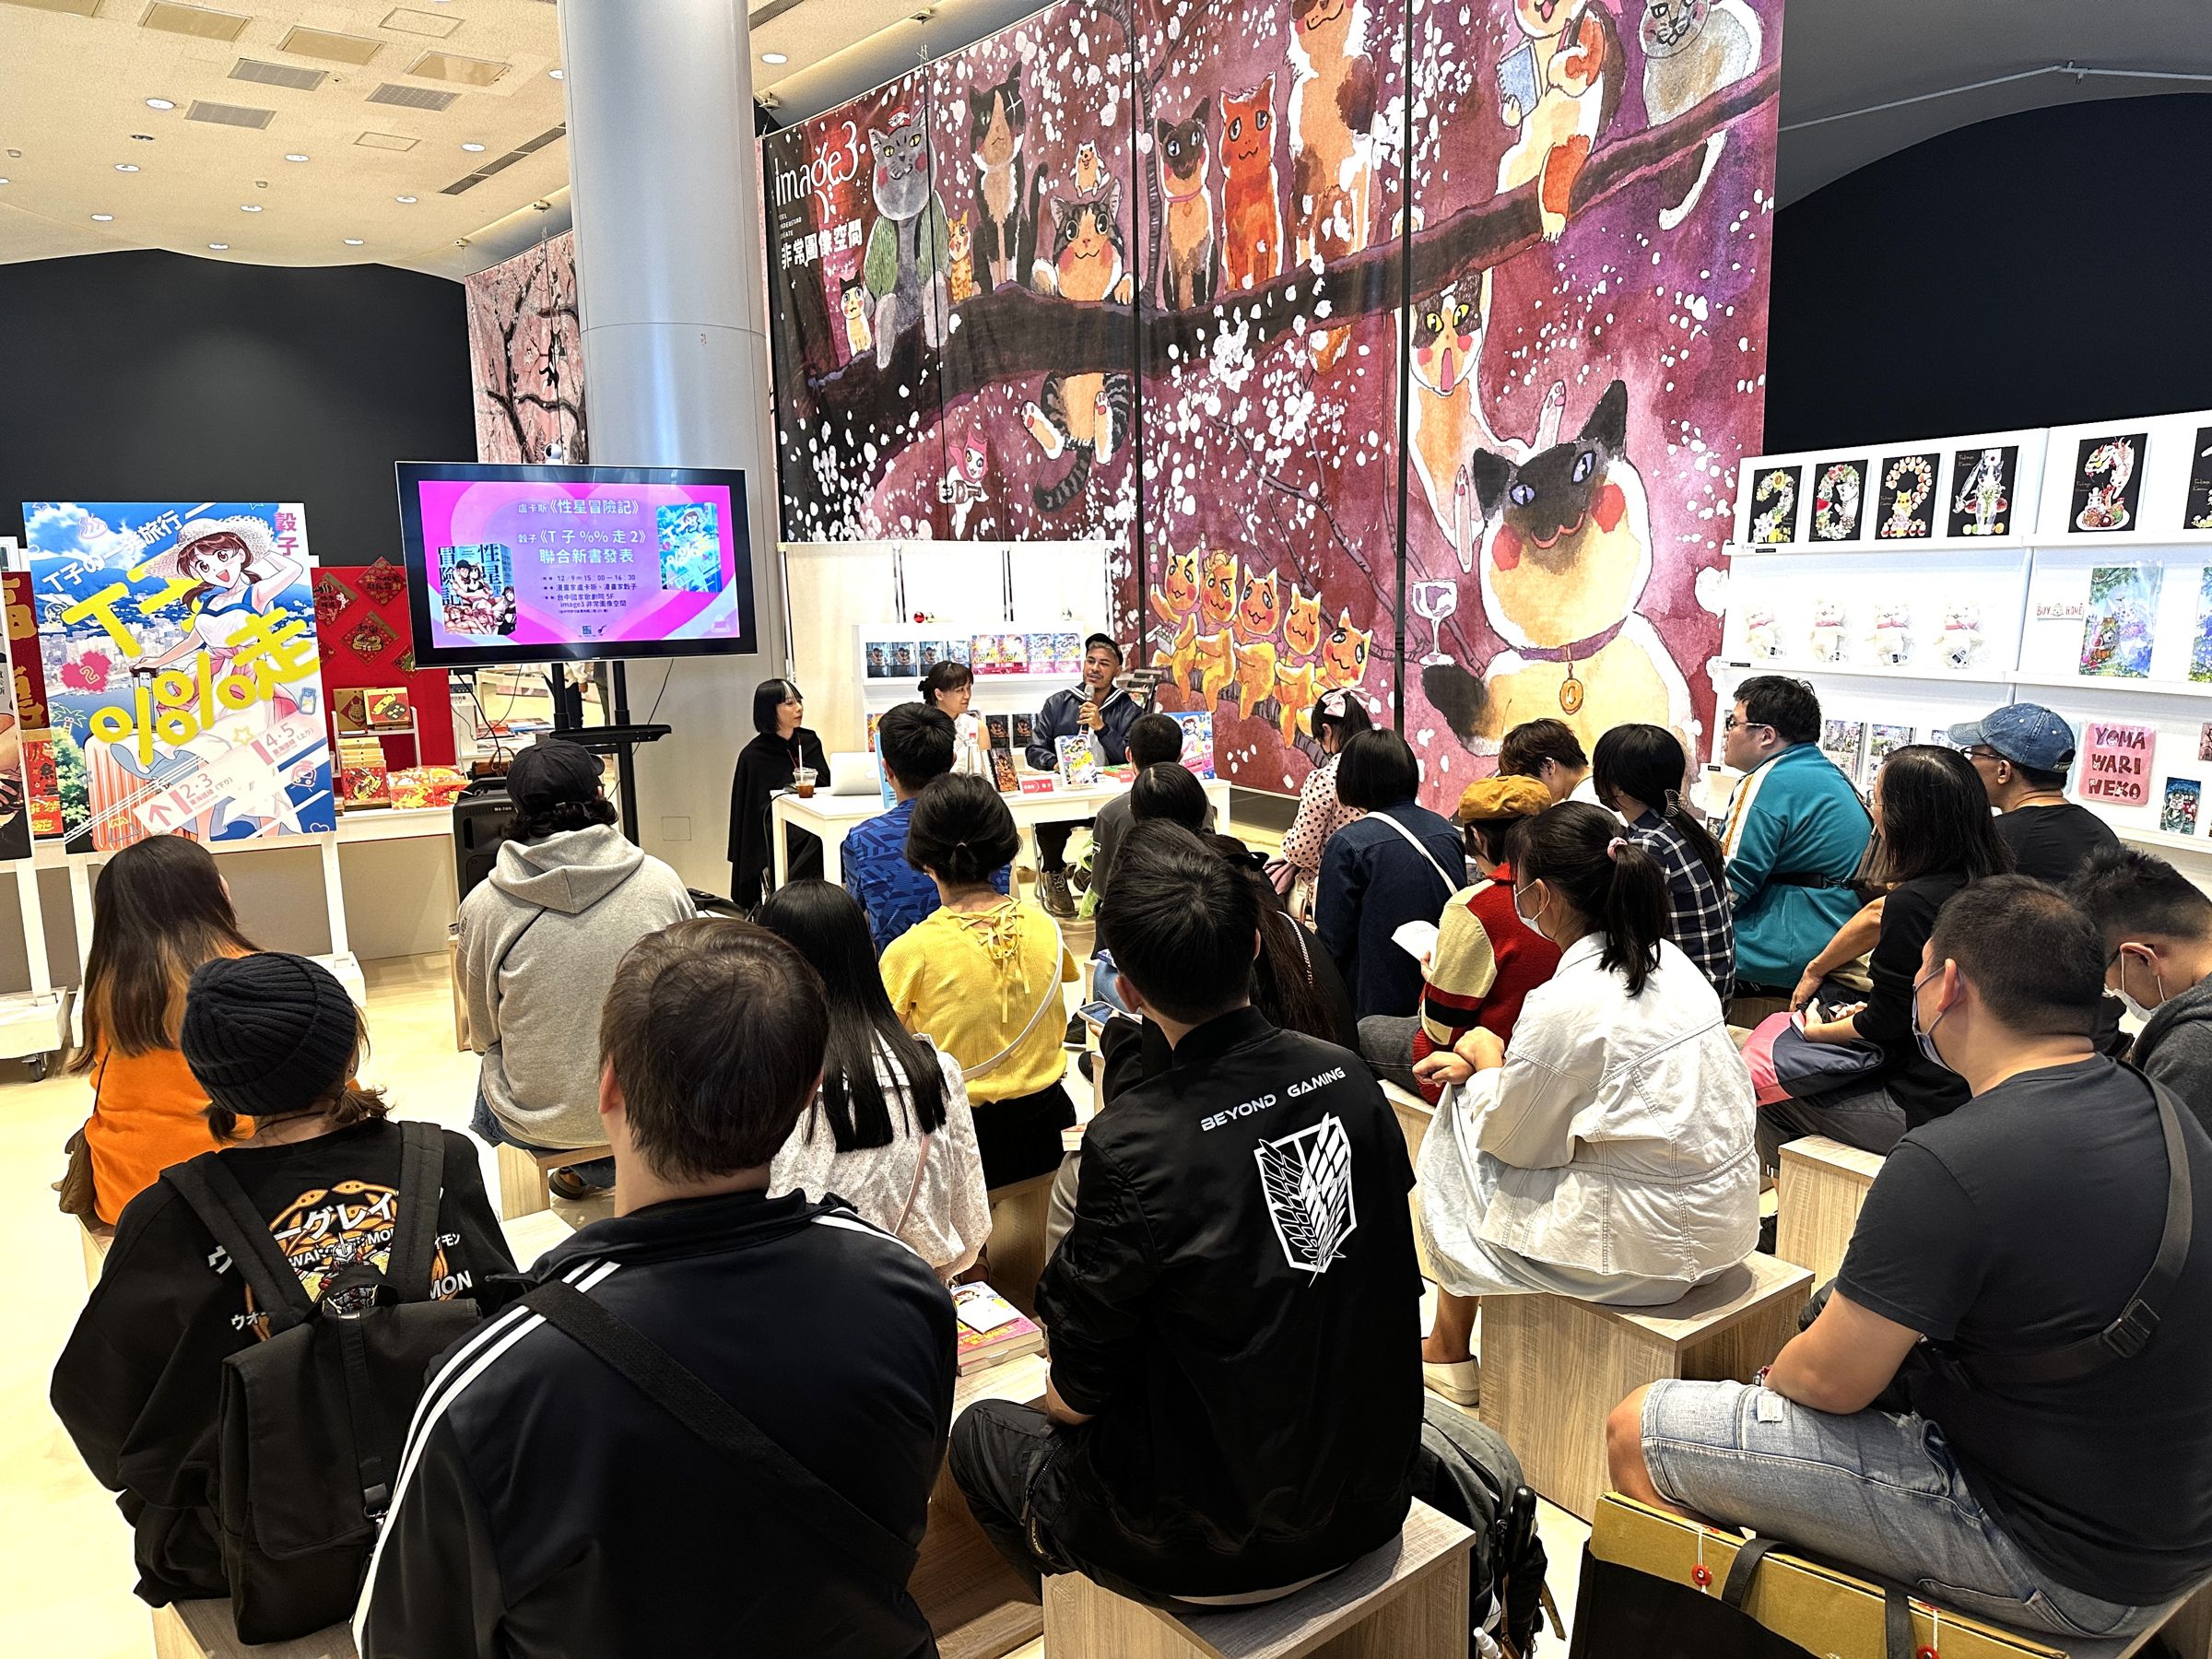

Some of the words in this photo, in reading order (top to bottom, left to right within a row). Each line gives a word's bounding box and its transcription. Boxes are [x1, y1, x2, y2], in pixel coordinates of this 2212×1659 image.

[782, 218, 863, 270] 非常圖像空間
[538, 547, 634, 564] 聯合新書發表
[2091, 754, 2142, 775] WARI
[1200, 1094, 1277, 1132] BEYOND
[1287, 1066, 1347, 1098] GAMING
